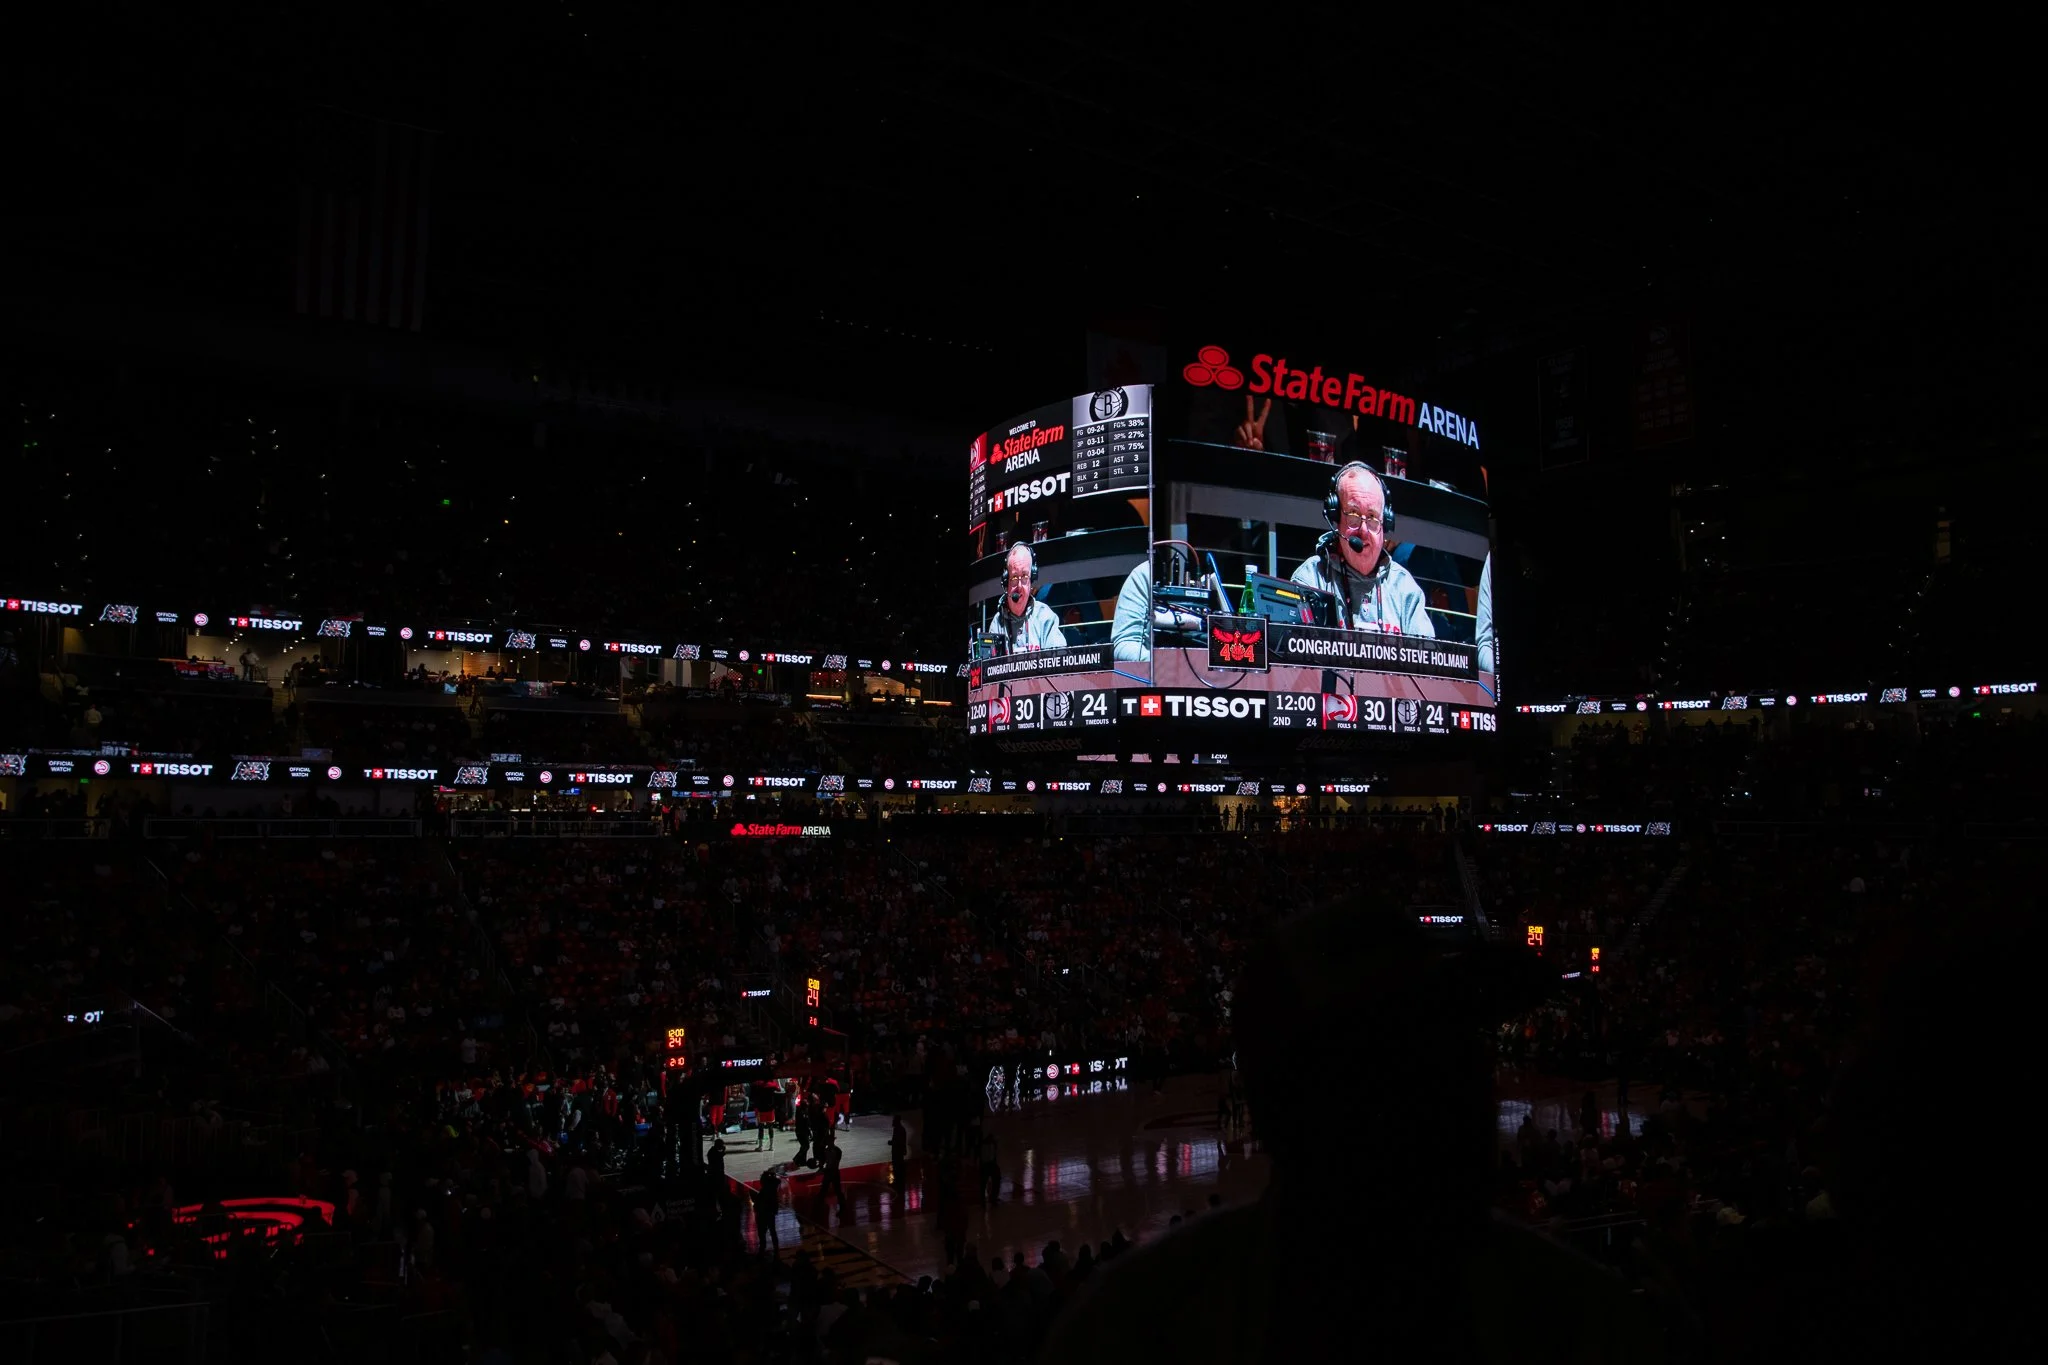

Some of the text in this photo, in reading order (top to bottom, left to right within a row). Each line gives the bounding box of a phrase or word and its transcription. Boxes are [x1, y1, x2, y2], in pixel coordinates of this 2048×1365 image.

[1009, 420, 1036, 436] WELCOME TO
[1418, 402, 1479, 449] ARENA
[1128, 430, 1144, 438] 27%
[1087, 436, 1104, 446] 03-11
[1128, 442, 1144, 450] 75%
[1087, 448, 1104, 456] 03-04
[1005, 448, 1040, 473] ARENA
[1092, 460, 1100, 468] 12
[1004, 472, 1070, 508] TISSOT
[21, 600, 82, 615] TISSOT
[250, 617, 302, 631] TISSOT
[446, 631, 492, 643] TISSOT
[620, 643, 662, 654] TISSOT
[1288, 638, 1468, 670] CONGRATULATIONS STEVE HOLMAN!
[776, 654, 812, 664] TISSOT
[914, 663, 948, 674] TISSOT
[987, 658, 1037, 676] CONGRATULATIONS
[1038, 657, 1060, 669] STEVE
[1062, 654, 1100, 666] HOLMAN!
[1990, 682, 2038, 694] TISSOT
[1082, 692, 1108, 716] 24
[1276, 694, 1316, 712] 12:00
[1826, 693, 1868, 704] TISSOT
[1016, 698, 1034, 721] 30
[1164, 695, 1266, 719] TISSOT
[1530, 704, 1566, 713] TISSOT
[1672, 700, 1711, 710] TISSOT
[971, 704, 986, 720] 12:00
[1364, 700, 1386, 722] 30
[1426, 704, 1444, 726] 24
[1085, 718, 1109, 726] TIMEOUTS
[1273, 716, 1317, 727] 2ND 24
[48, 760, 74, 768] OFFICIAL
[154, 763, 213, 776] TISSOT
[288, 766, 310, 774] OFFICIAL
[384, 768, 438, 780] TISSOT
[586, 774, 634, 784] TISSOT
[764, 778, 806, 787] TISSOT
[920, 780, 957, 790] TISSOT
[1058, 782, 1090, 791] TISSOT
[1190, 784, 1226, 793] TISSOT
[1334, 785, 1370, 793] TISSOT
[802, 825, 831, 836] ARENA
[1604, 825, 1642, 833] TISSOT
[1528, 933, 1542, 946] 24
[807, 988, 819, 1008] 24
[668, 1028, 684, 1038] 12:00
[668, 1037, 682, 1048] 24
[732, 1058, 763, 1067] TISSOT
